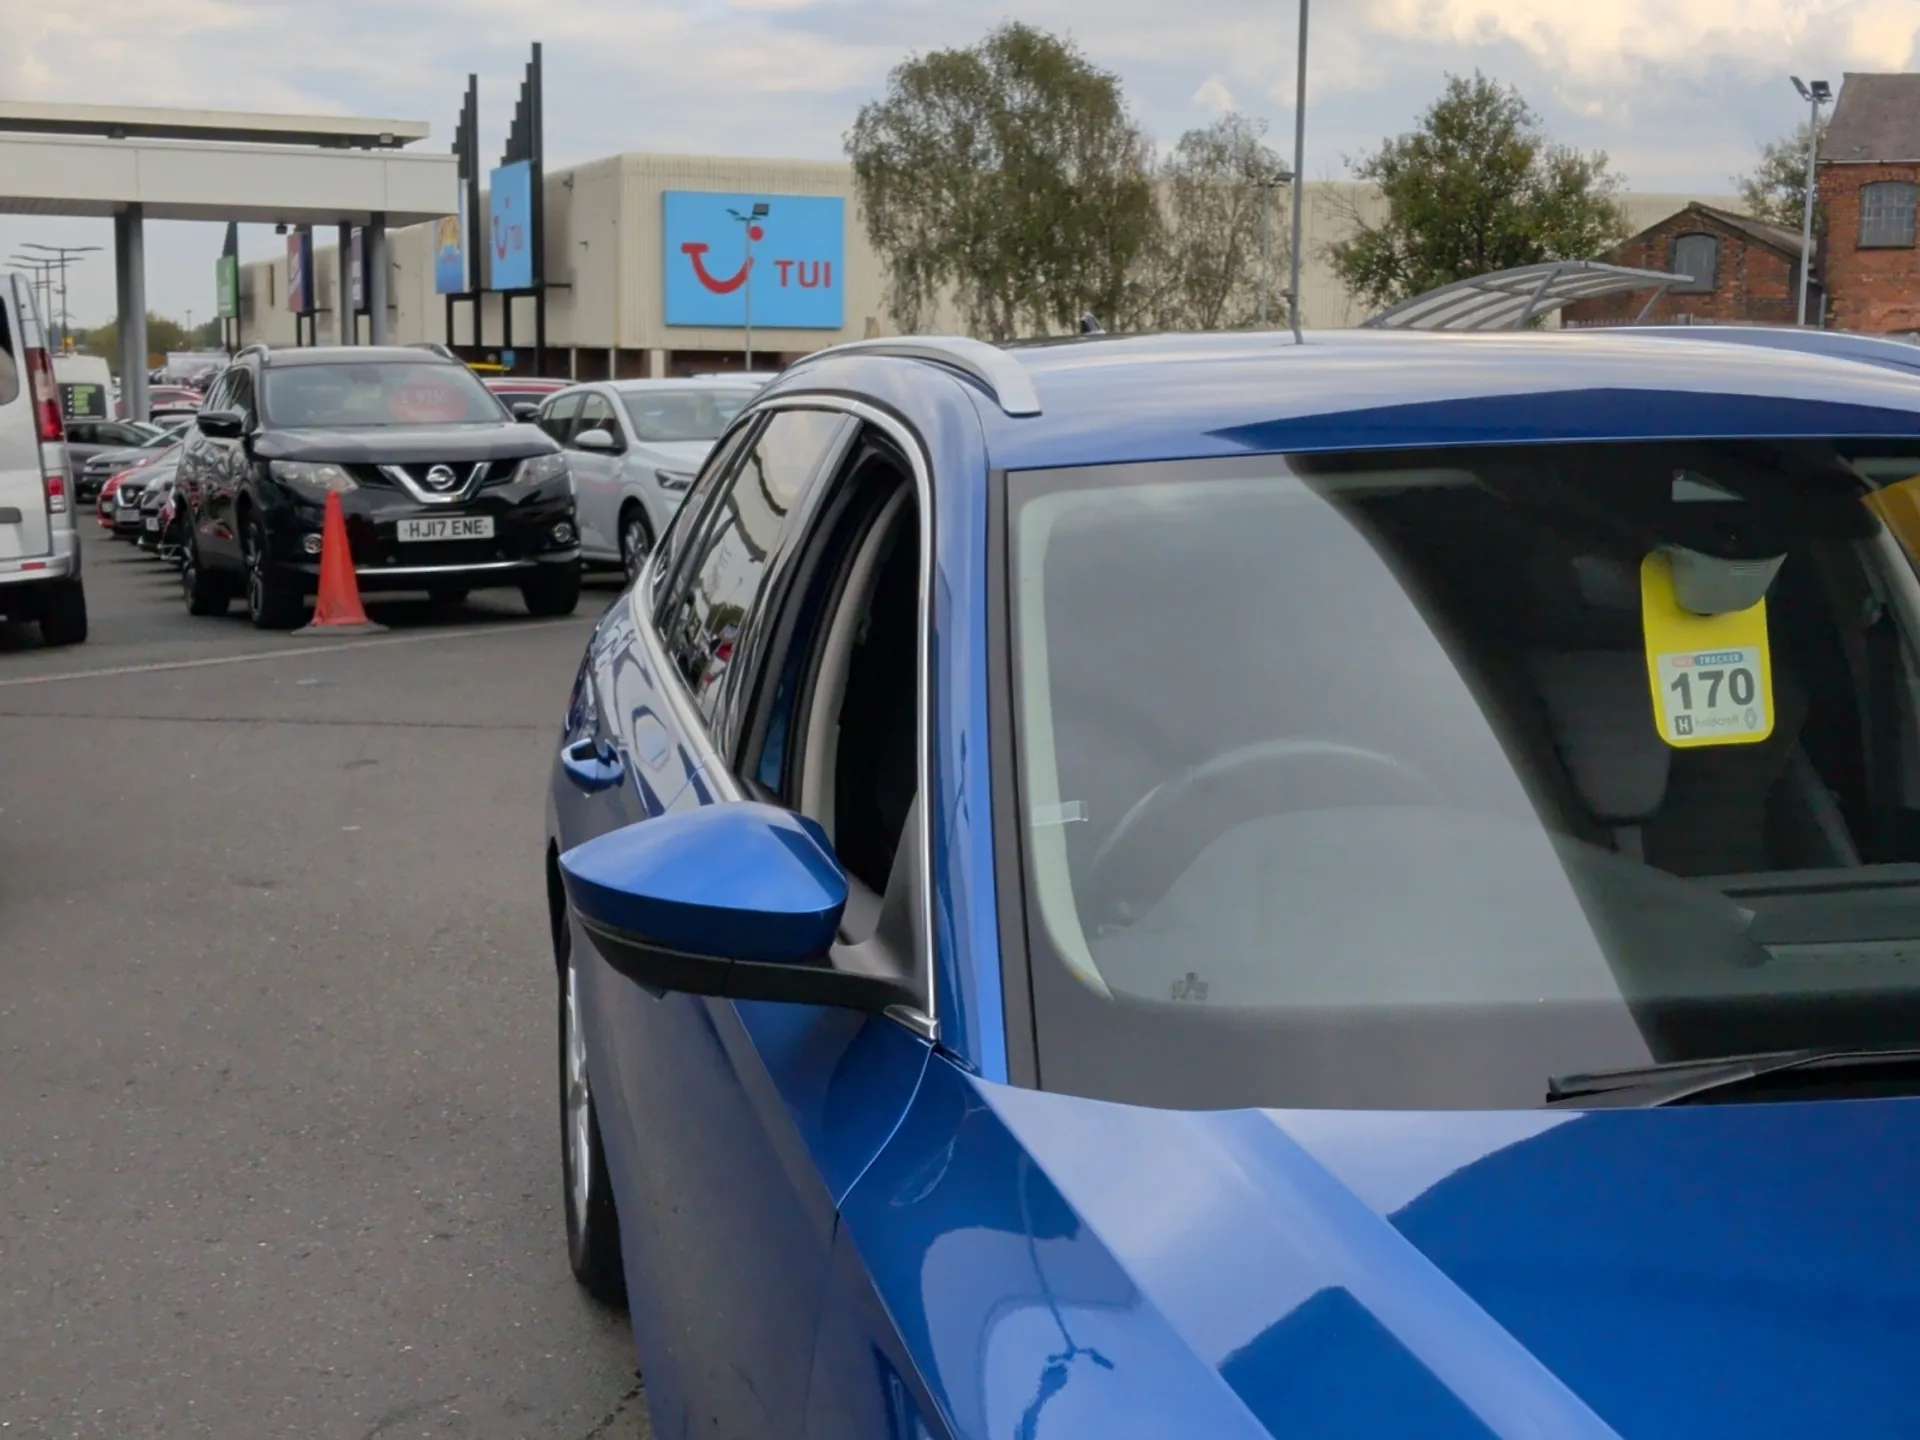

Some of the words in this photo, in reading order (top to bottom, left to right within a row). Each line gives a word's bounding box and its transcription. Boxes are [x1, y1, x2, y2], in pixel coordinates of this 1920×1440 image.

[774, 260, 832, 288] TUI
[409, 520, 447, 538] HJ17
[452, 519, 484, 536] ENE
[1671, 668, 1754, 709] 170
